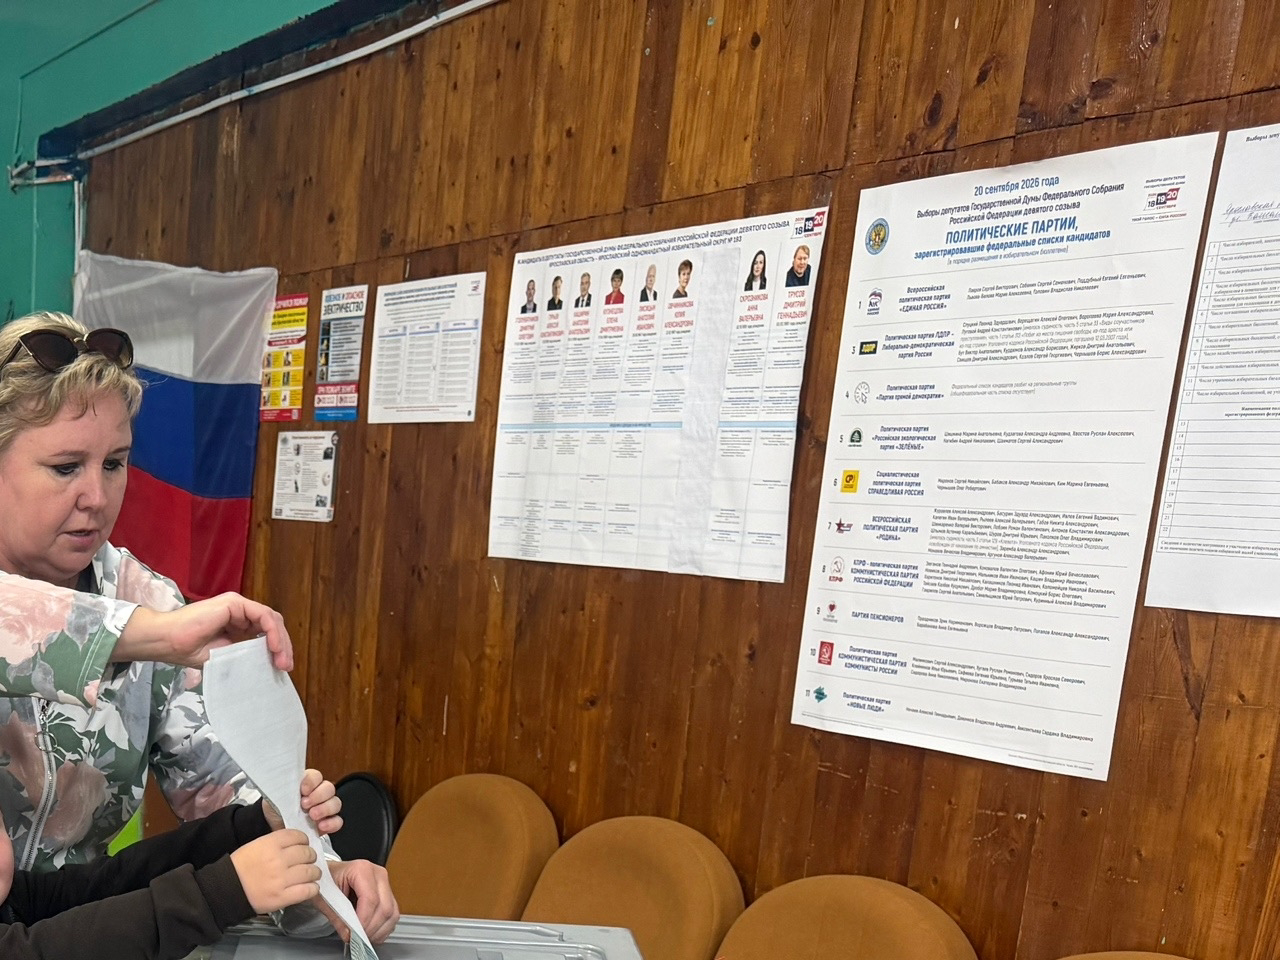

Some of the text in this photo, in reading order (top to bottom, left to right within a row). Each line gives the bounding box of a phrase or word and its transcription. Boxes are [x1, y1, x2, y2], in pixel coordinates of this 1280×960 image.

[974, 176, 1060, 196] 20 сентября 2026 года
[917, 184, 1125, 218] Выборы депутатов Государственной Думы Федерального Собрания
[949, 202, 1080, 225] Российской Федерации девятого созыва
[710, 228, 738, 238] ФЕДЕРАЦИИ
[739, 224, 767, 234] ДЕВЯТОГО
[768, 220, 790, 230] СОЗЫВА
[805, 220, 813, 229] 19
[814, 215, 823, 224] 20
[946, 216, 1078, 244] ПОЛИТИЧЕСКИЕ ПАРТИИ,
[914, 230, 1110, 260] зарегистрировавшие федеральные списки кандидатов
[899, 296, 932, 304] политическая
[872, 515, 911, 524] ВСЕРОССИЙСКАЯ
[863, 524, 899, 532] ПОЛИТИЧЕСКАЯ
[854, 576, 913, 587] РОССИЙСКОЙ ФЕДЕРАЦИИ
[870, 613, 904, 623] ПЕНСИОНЕРОВ
